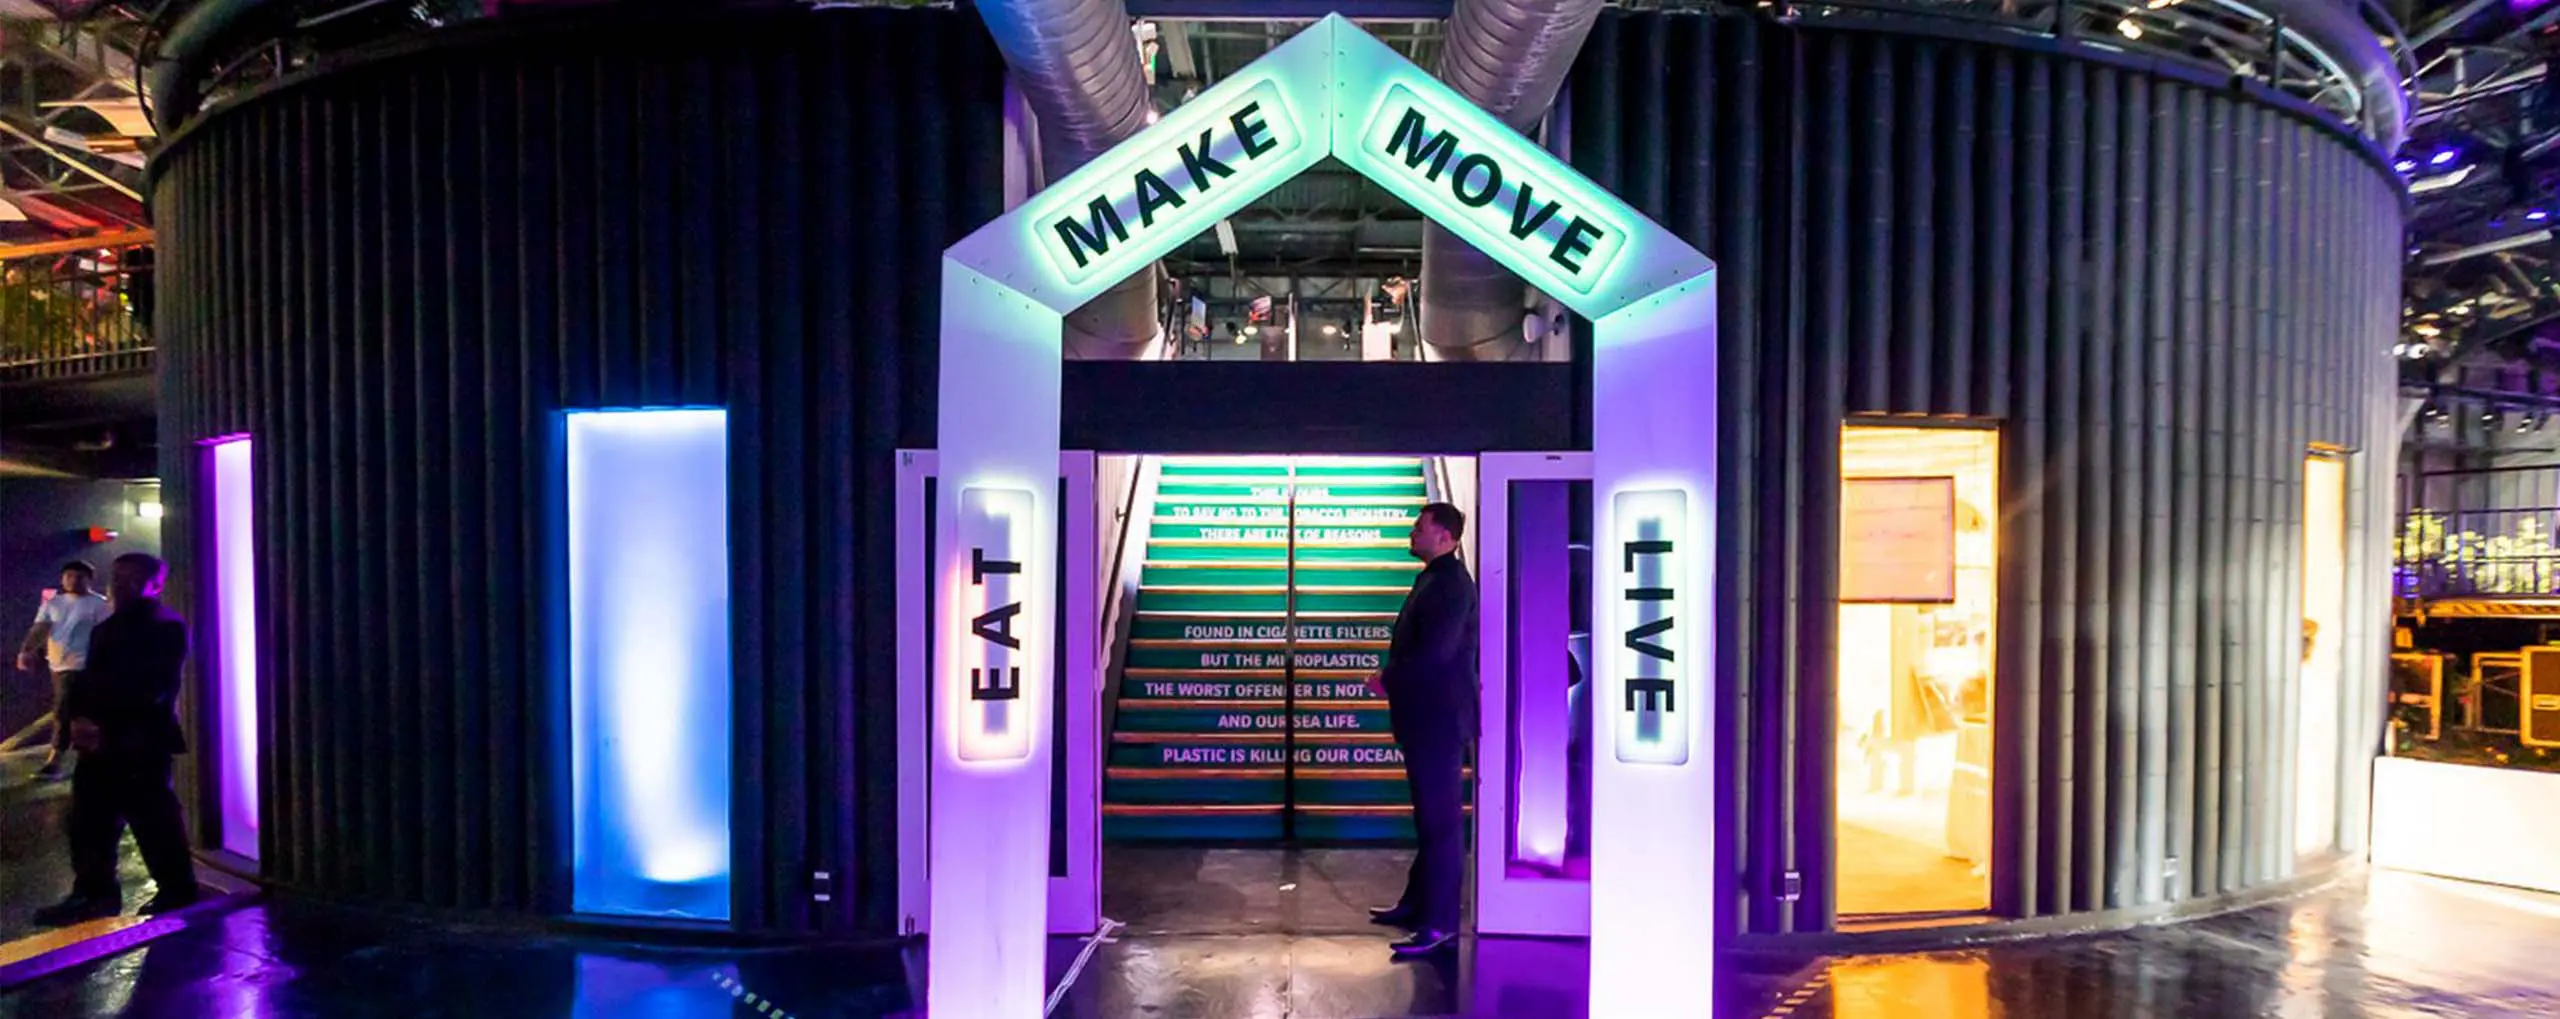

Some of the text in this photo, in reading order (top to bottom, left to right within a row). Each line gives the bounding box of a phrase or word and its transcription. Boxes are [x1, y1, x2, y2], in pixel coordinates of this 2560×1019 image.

[1054, 100, 1278, 268] MAKE
[1385, 106, 1604, 275] MOVE
[1288, 507, 1342, 518] OBACCO
[971, 548, 1021, 700] EAT
[1624, 541, 1674, 712] LIVE
[1184, 625, 1234, 638] FOUND
[1238, 625, 1253, 638] IN
[1201, 653, 1379, 667] BUT THE MIROPLASTICS
[1144, 683, 1174, 696] THE
[1178, 683, 1230, 696] WORST
[1235, 684, 1313, 697] OFFENER
[1317, 684, 1331, 697] IS
[1335, 684, 1364, 697] NOT
[1217, 714, 1360, 728] AND OUR SEA LIFE.
[1163, 748, 1226, 762] PLASTIC
[1231, 749, 1245, 762] IS
[1315, 749, 1349, 762] OUR
